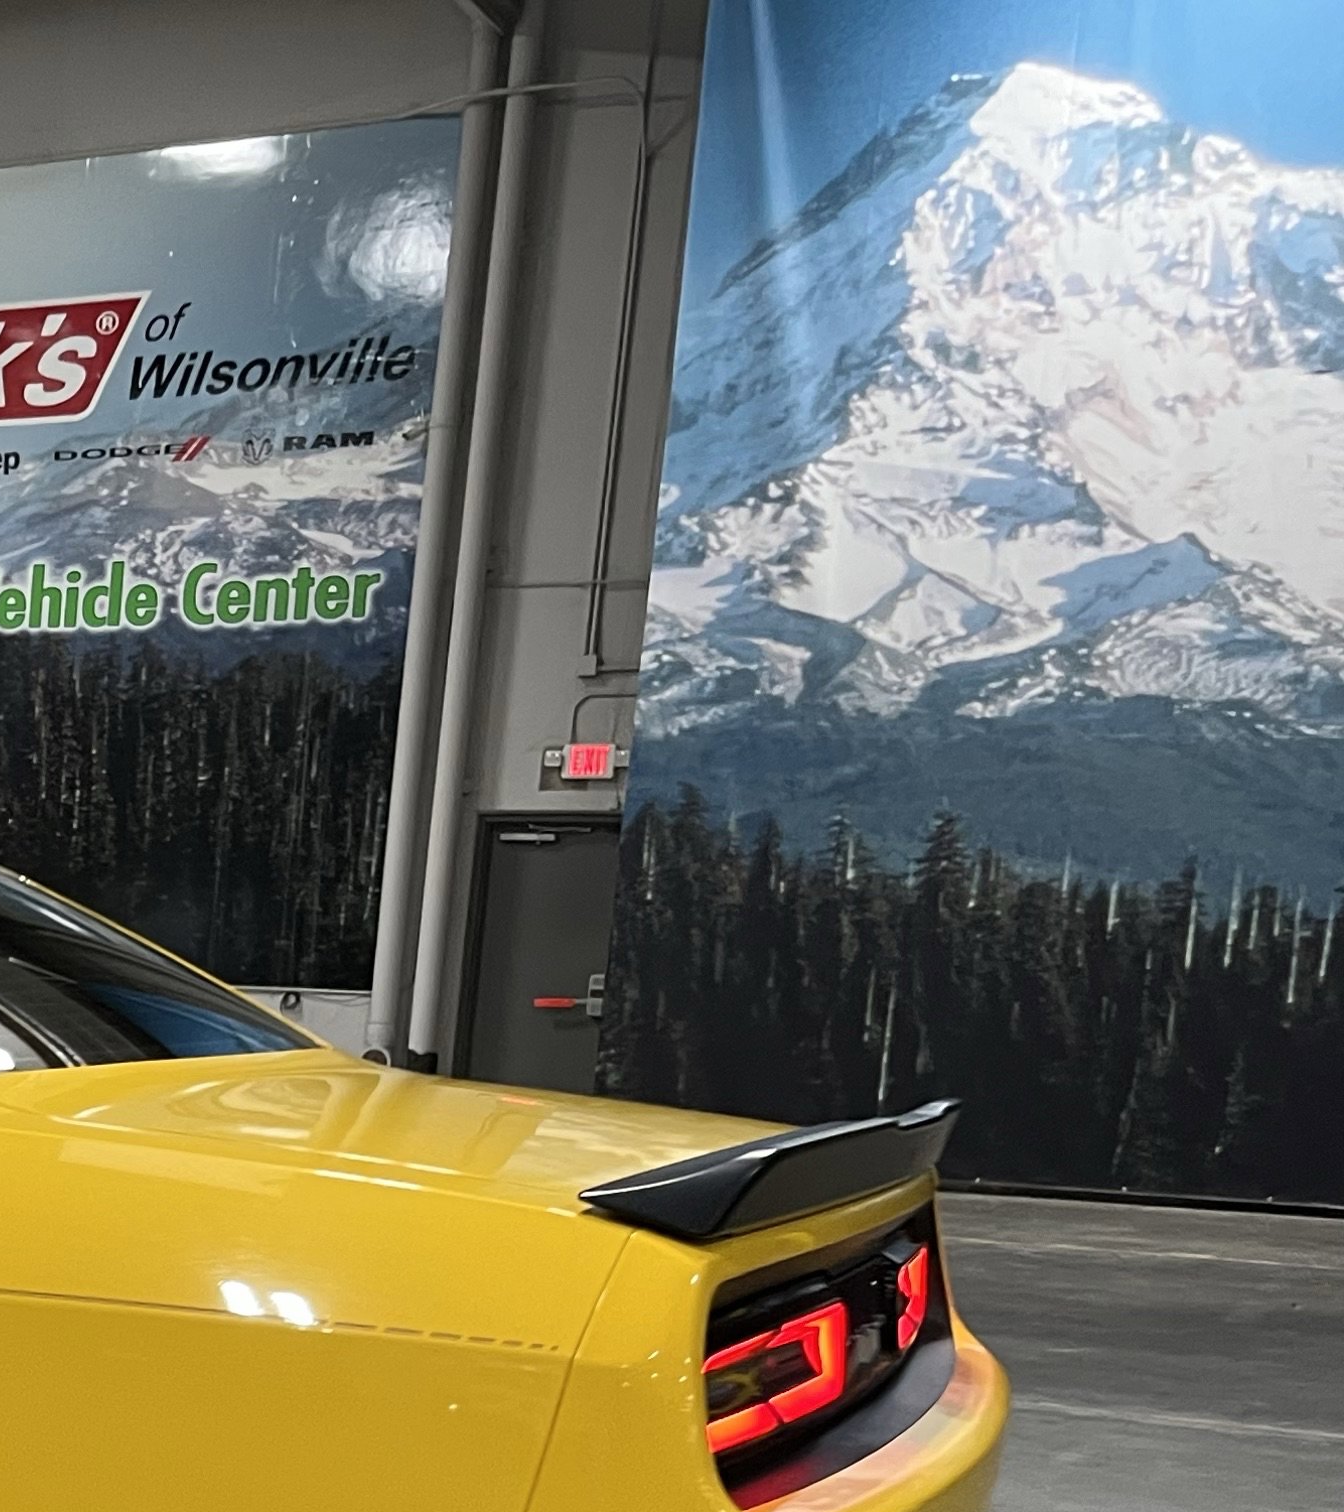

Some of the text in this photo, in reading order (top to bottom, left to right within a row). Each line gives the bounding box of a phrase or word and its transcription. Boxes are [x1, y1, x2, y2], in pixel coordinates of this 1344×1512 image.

[146, 302, 191, 342] of
[129, 333, 416, 401] Wilsonville
[54, 442, 184, 462] DODGE
[283, 431, 375, 452] RAM
[183, 562, 382, 627] Center
[570, 744, 609, 775] EXIT
